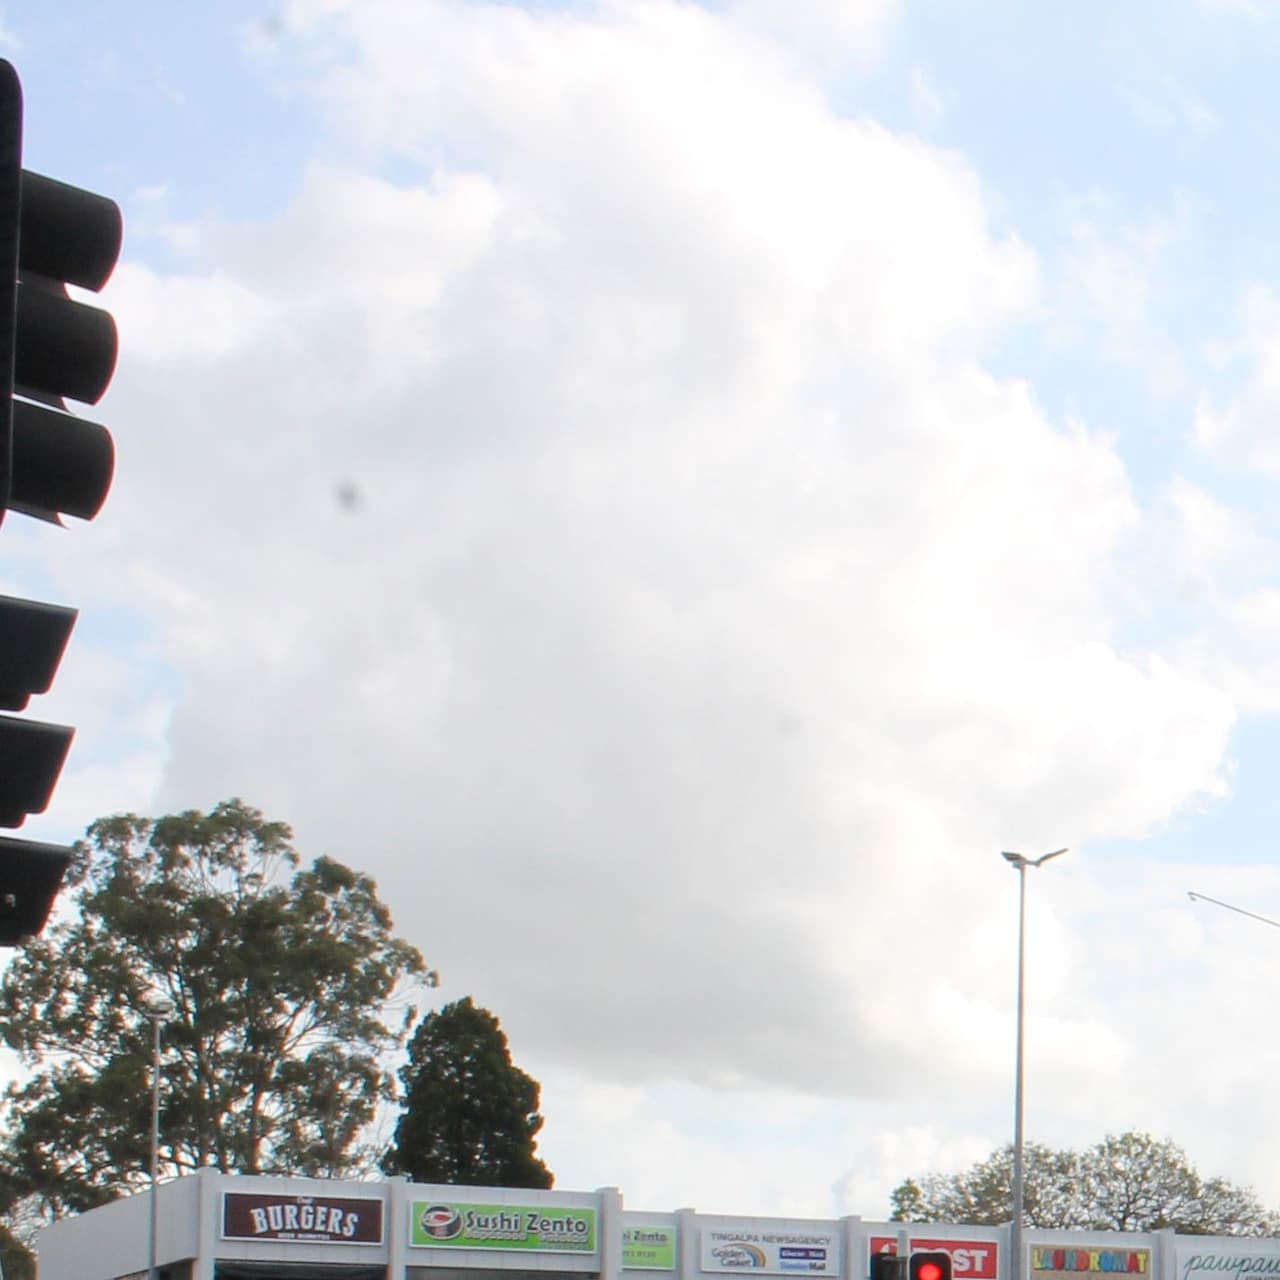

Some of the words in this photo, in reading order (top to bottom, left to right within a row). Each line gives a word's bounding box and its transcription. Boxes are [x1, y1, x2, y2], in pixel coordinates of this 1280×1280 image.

[250, 1204, 359, 1237] BURGERS
[466, 1210, 521, 1231] Sushi
[527, 1213, 588, 1234] Zento
[711, 1232, 760, 1242] TINGALPA
[1033, 1249, 1148, 1272] LAUNDROMAT
